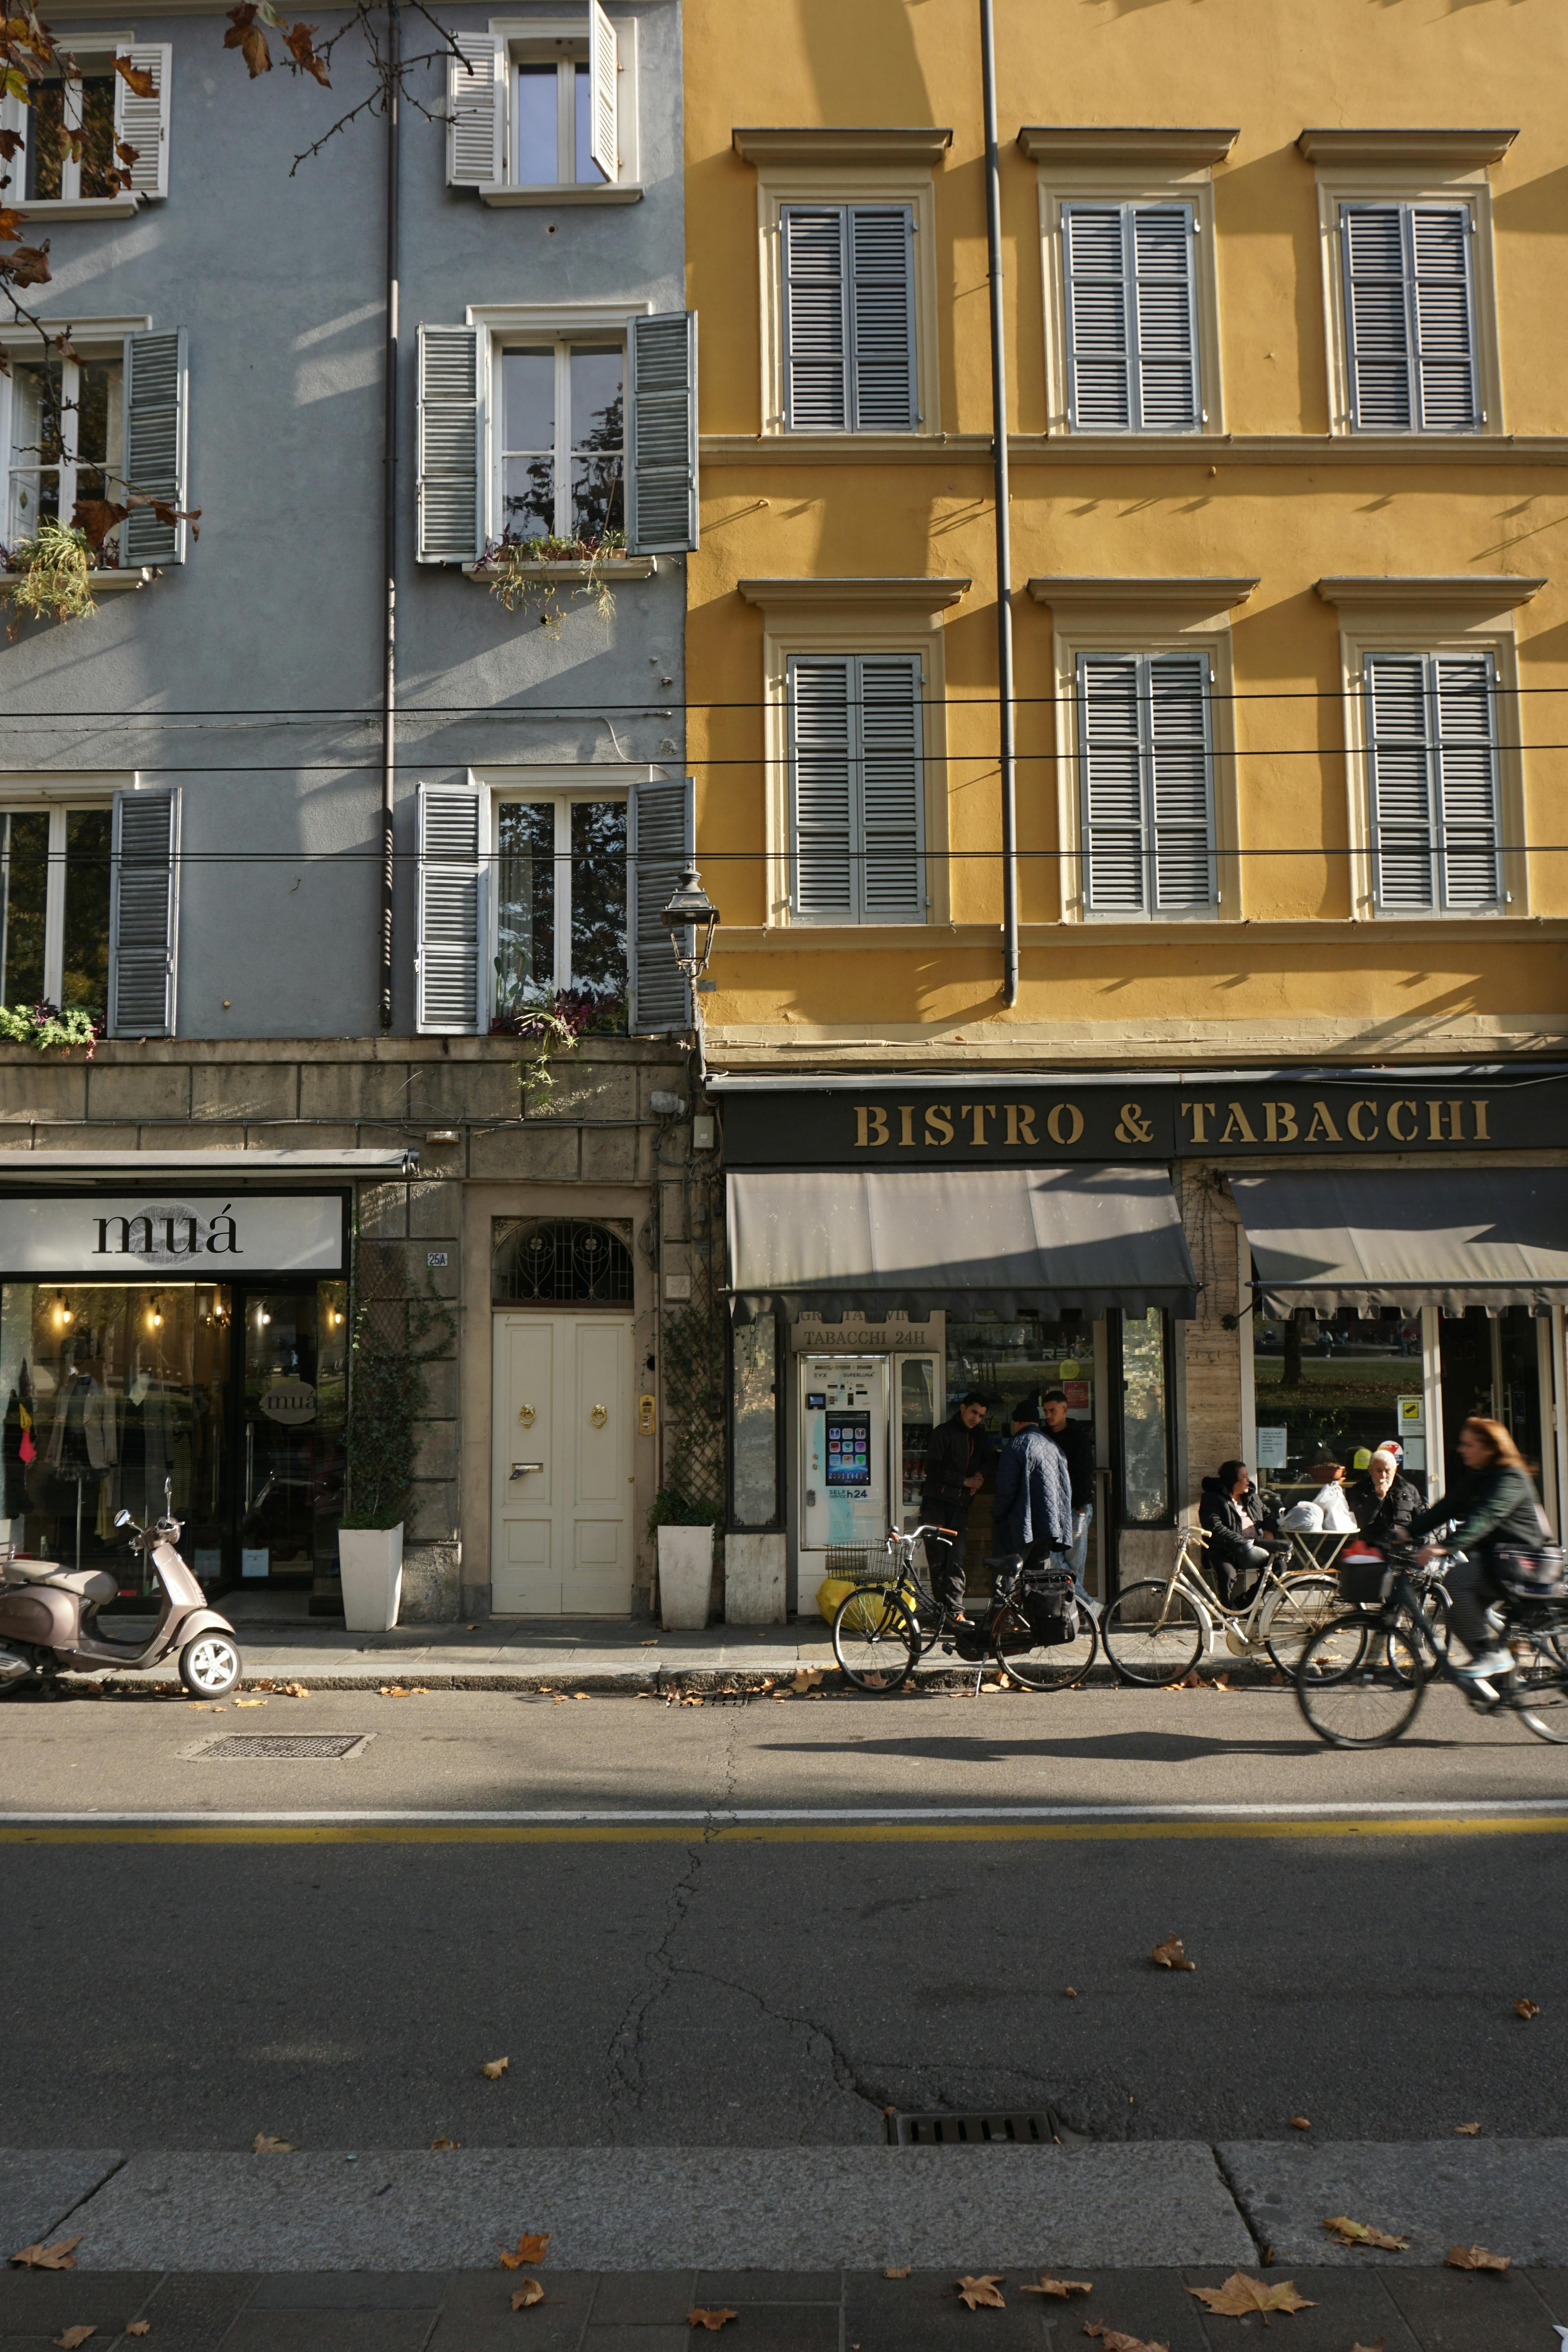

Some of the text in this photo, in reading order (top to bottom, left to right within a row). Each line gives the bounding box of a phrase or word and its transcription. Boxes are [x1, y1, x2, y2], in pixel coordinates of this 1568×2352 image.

[853, 1100, 1491, 1147] BISTRO & TABACCHI
[92, 1203, 244, 1254] muá
[800, 1311, 864, 1321] GRTA
[804, 1331, 926, 1345] TABACCHI 24H
[266, 1390, 318, 1409] muá
[847, 1490, 867, 1498] h24
